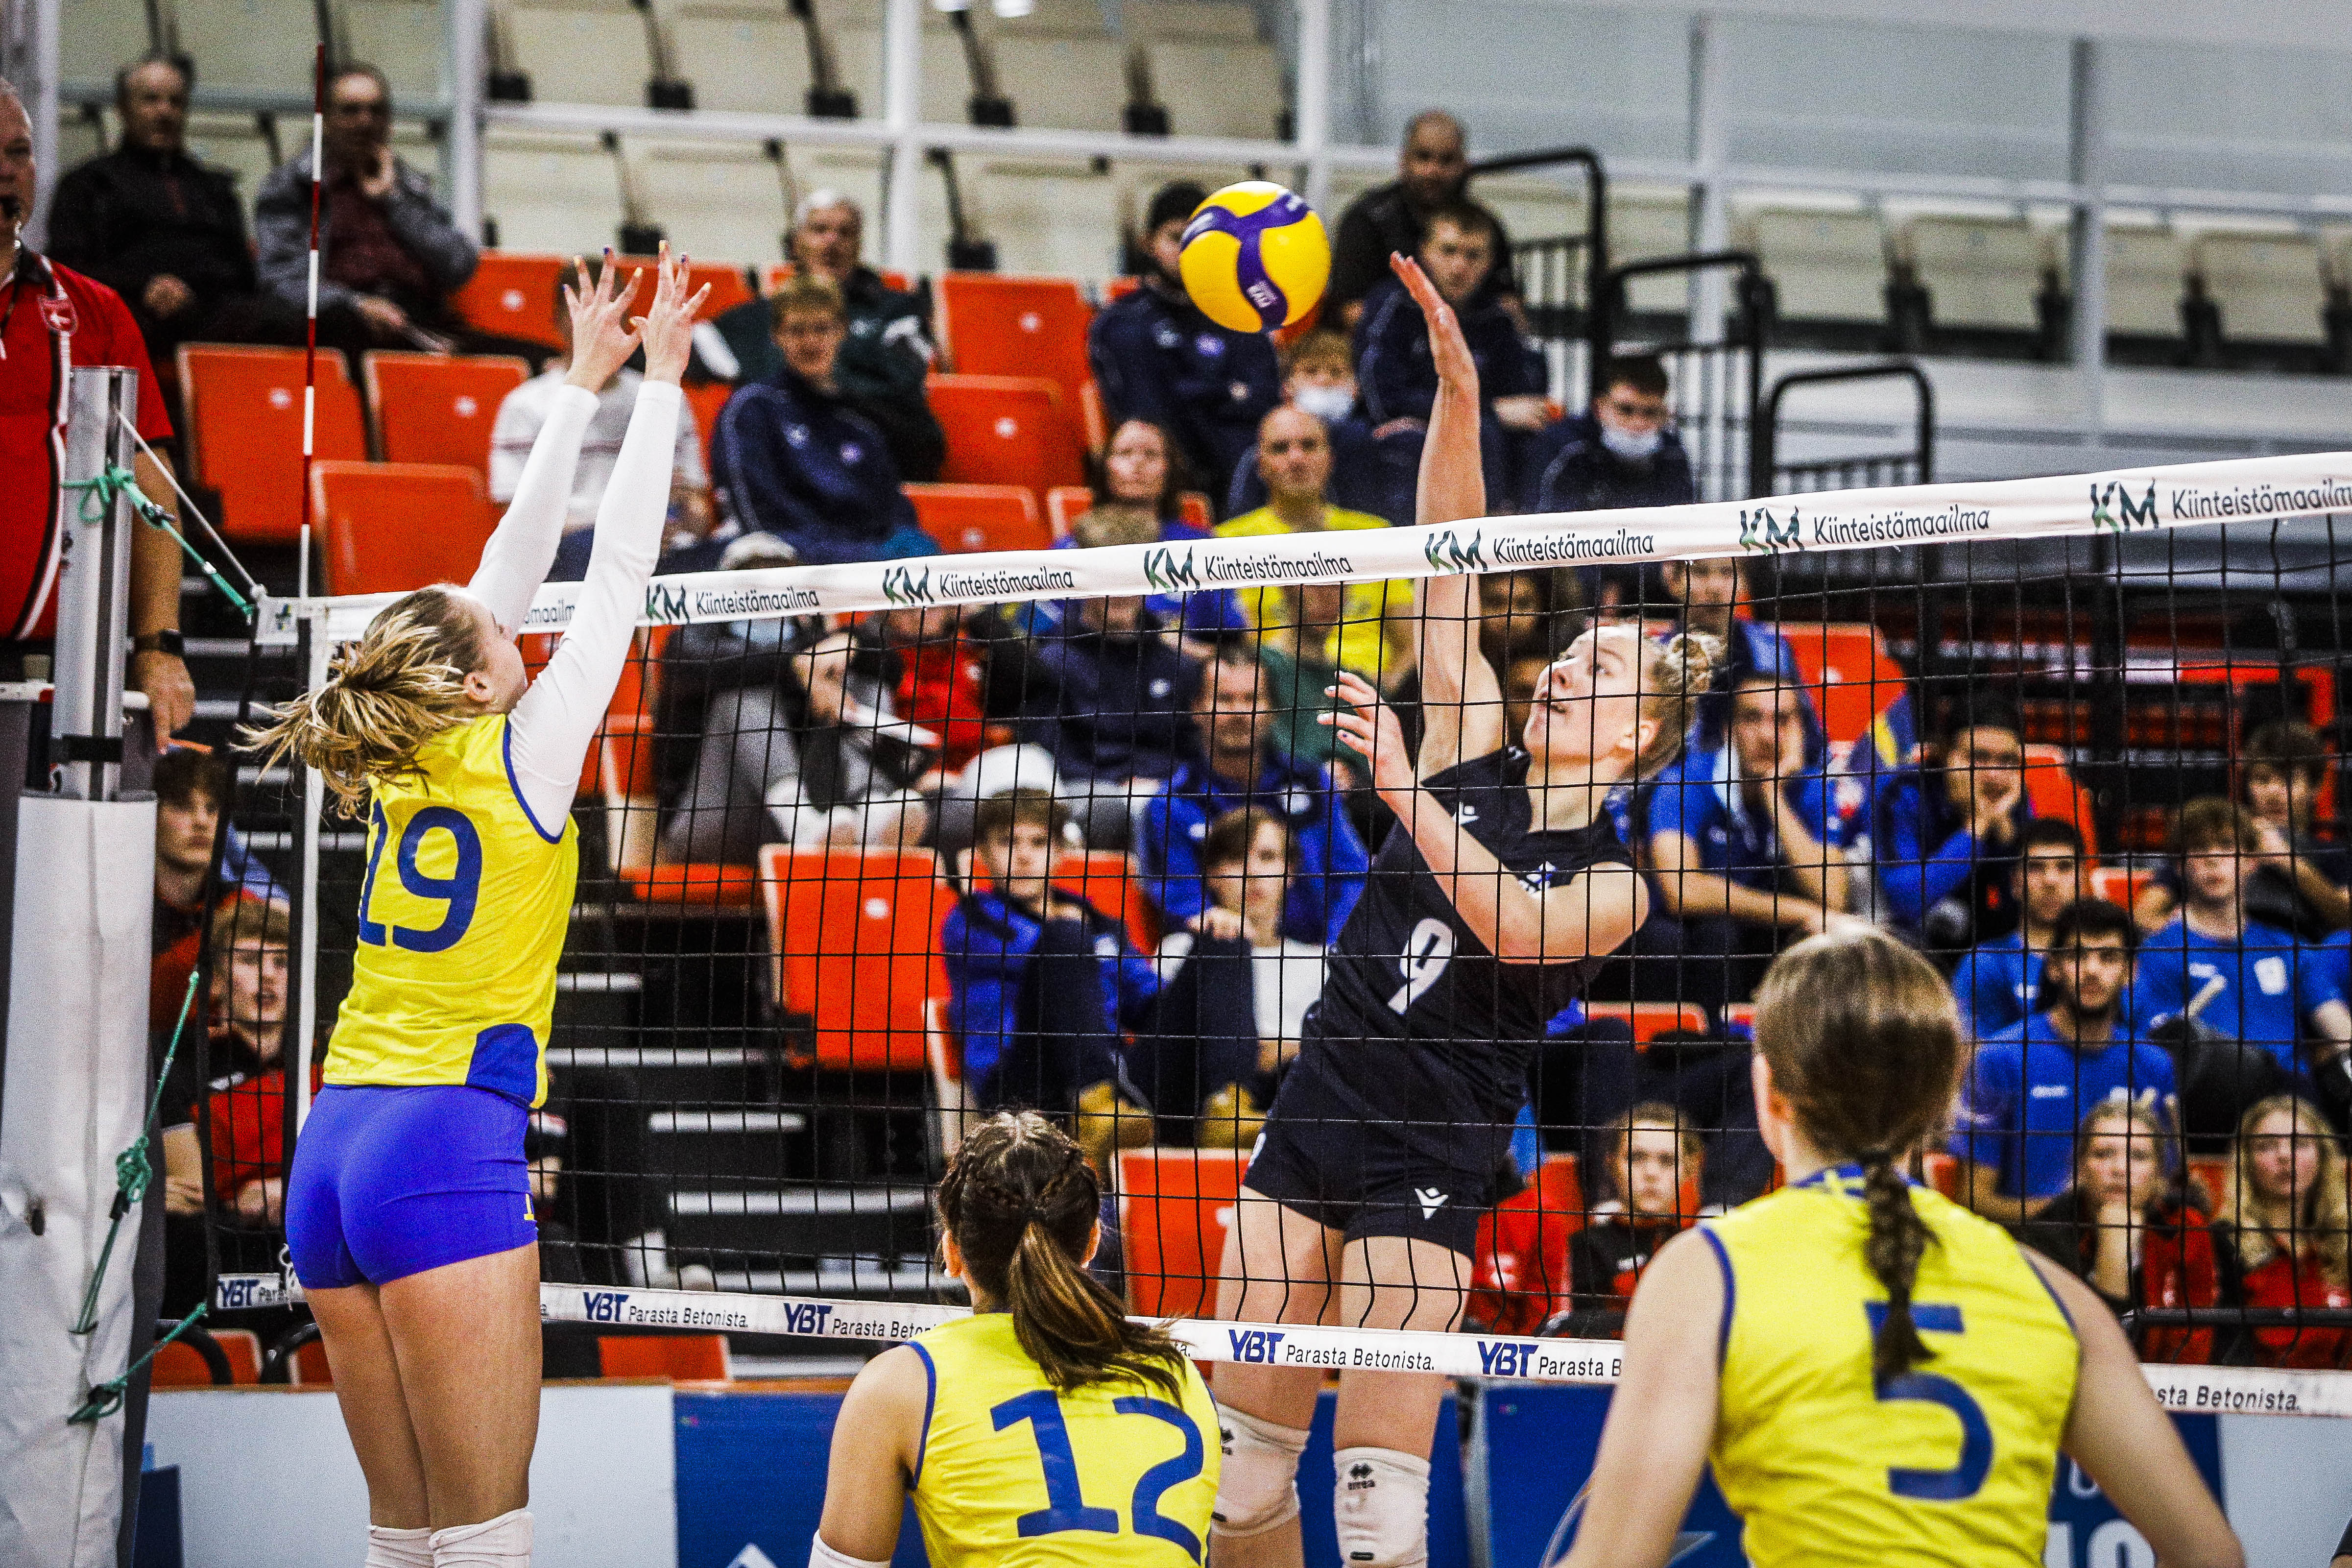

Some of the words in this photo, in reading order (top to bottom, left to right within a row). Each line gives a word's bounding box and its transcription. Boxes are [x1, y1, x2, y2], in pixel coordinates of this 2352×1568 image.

[2091, 478, 2159, 533] KM
[1424, 528, 1488, 577] KM
[1494, 528, 1655, 564] Kiinteistömaailma
[1739, 505, 1805, 555] KM
[1814, 504, 1991, 544] Kiinteistömaailma
[882, 564, 935, 607] KM
[939, 566, 1075, 598] Kiinteistömaailma
[1144, 545, 1200, 594] KM
[1205, 551, 1354, 581] Kiinteistömaailma
[645, 583, 690, 624] KM
[696, 587, 820, 616] Kiinteistömaailma
[358, 798, 482, 953] 19
[1388, 917, 1458, 1015] 9
[218, 1279, 261, 1307] YBT
[583, 1292, 629, 1322] YBT
[629, 1305, 678, 1323] Parasta
[683, 1307, 748, 1328] Betonista.
[784, 1303, 832, 1334] YBT
[833, 1318, 885, 1337] Parasta
[1228, 1329, 1285, 1364] YBT
[1286, 1345, 1346, 1366] Parasta
[1354, 1348, 1435, 1371] Betonista.
[1478, 1341, 1539, 1377] YBT
[1539, 1356, 1604, 1377] Parasta
[1864, 1301, 1994, 1501] 5
[2196, 1385, 2301, 1411] Betonista.
[990, 1389, 1204, 1567] 12
